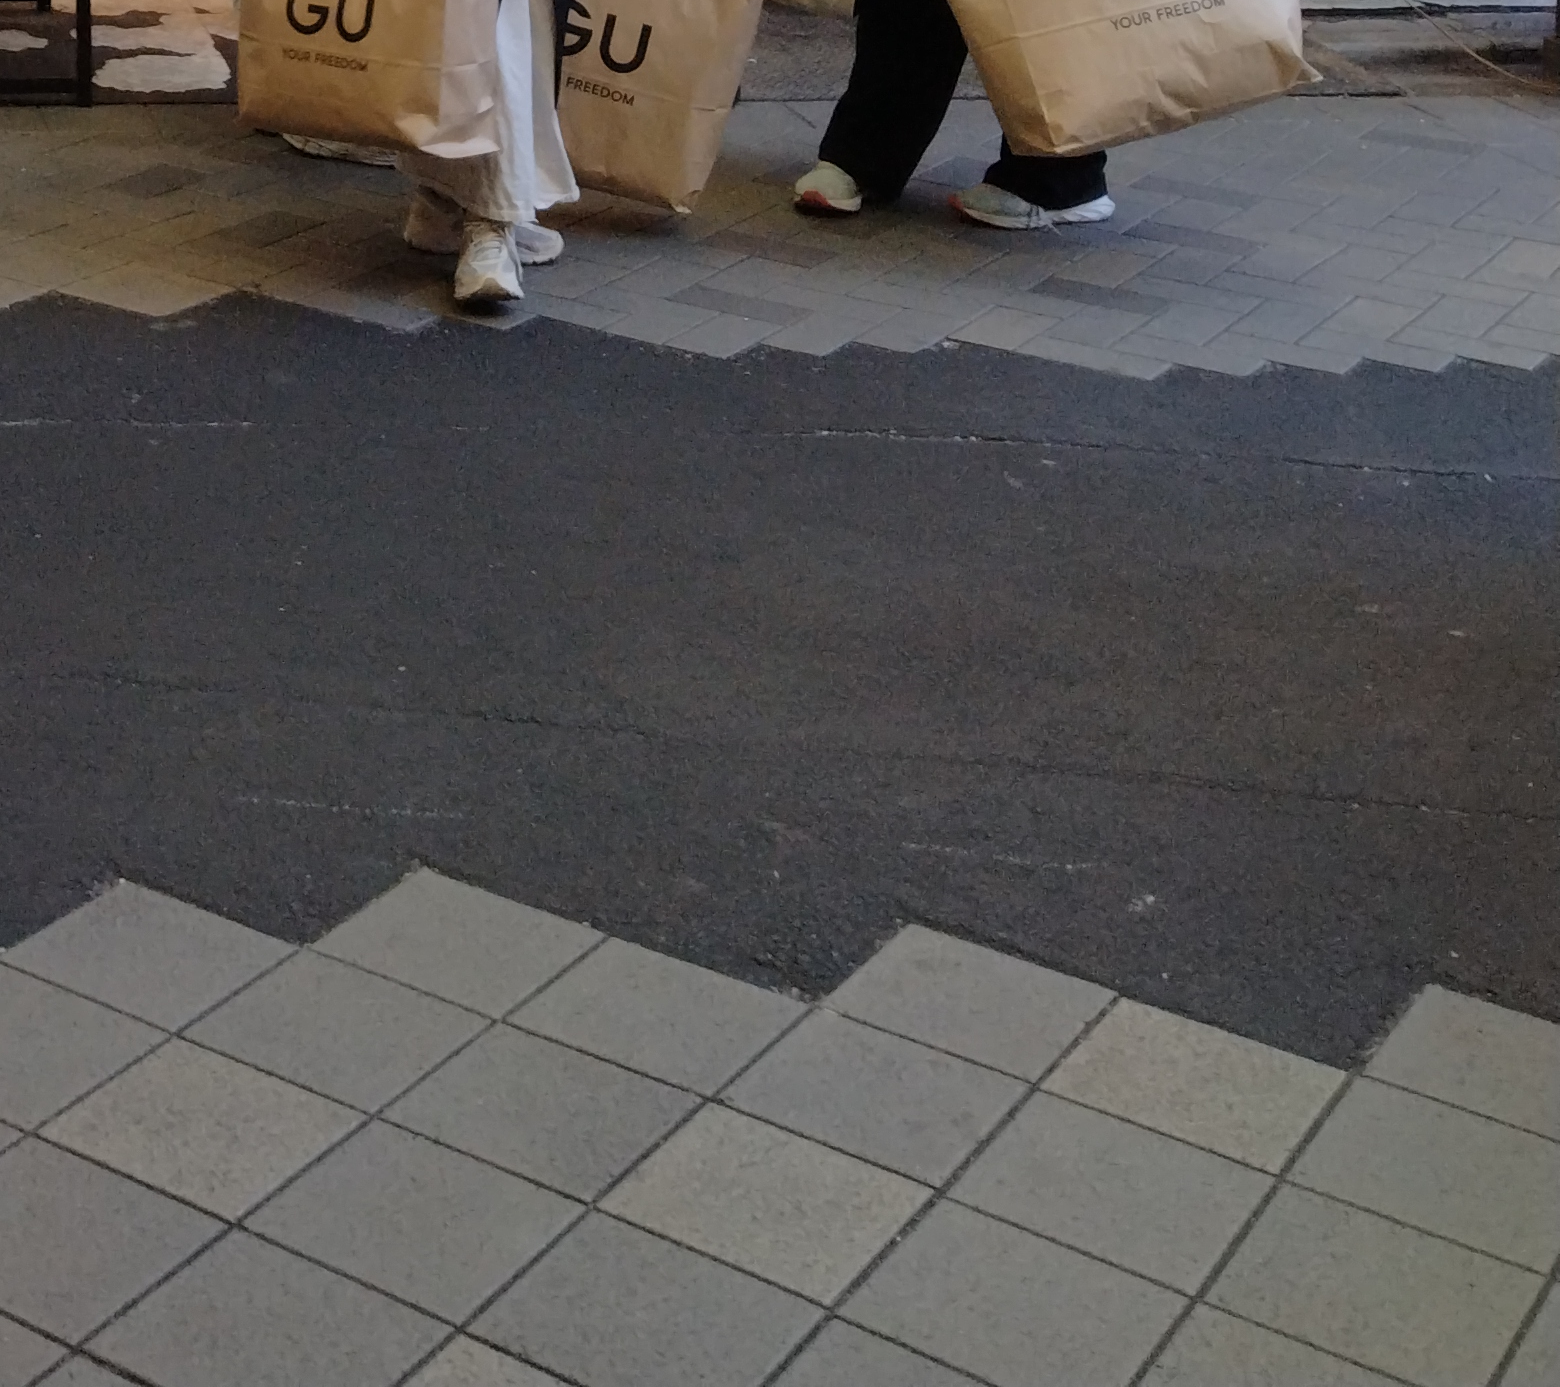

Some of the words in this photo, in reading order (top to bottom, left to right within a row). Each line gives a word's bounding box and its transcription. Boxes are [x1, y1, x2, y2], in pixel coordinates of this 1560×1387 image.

[1110, 11, 1153, 31] YOUR
[282, 47, 311, 62] YOUR
[314, 52, 368, 73] FREEDOM
[566, 76, 636, 106] FREEDOM
